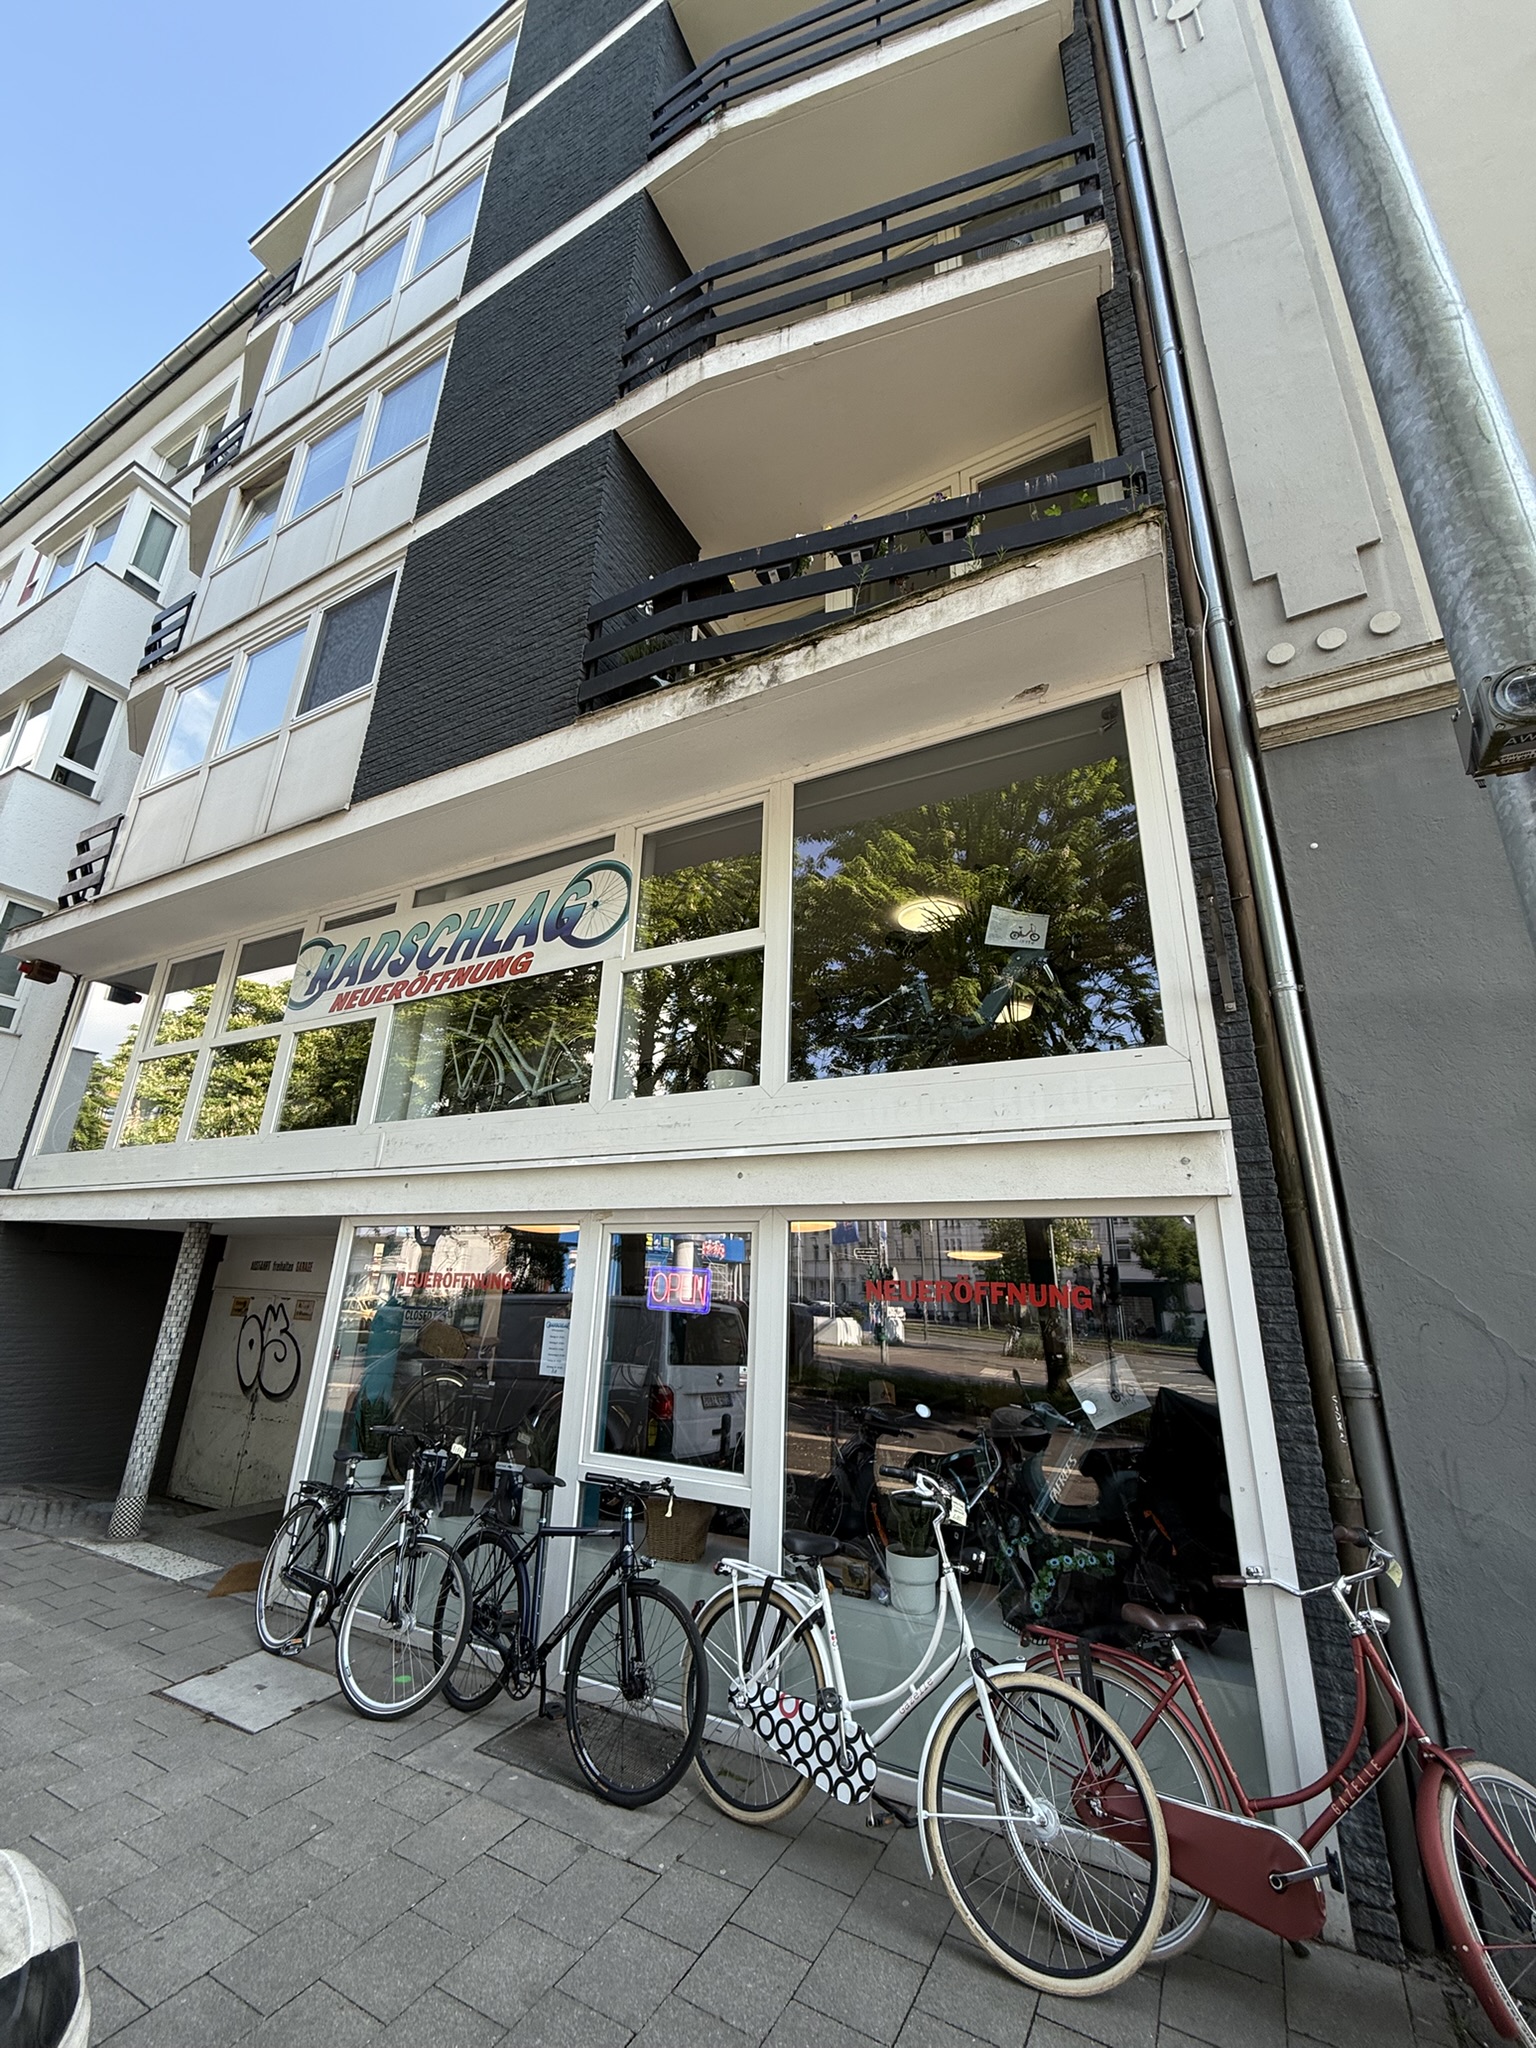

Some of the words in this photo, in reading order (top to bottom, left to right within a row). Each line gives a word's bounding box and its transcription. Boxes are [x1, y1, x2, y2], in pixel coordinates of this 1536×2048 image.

[304, 879, 592, 996] RADSCHLAG
[328, 951, 534, 1013] NEUERÖFFNUNG
[396, 1268, 513, 1291] NEUERÖFFNUNG
[651, 1272, 708, 1306] OPEN
[865, 1274, 1093, 1310] NEUERÖFFNUNG
[898, 1677, 935, 1715] Gazelle
[1330, 1758, 1382, 1816] GAZELLE
